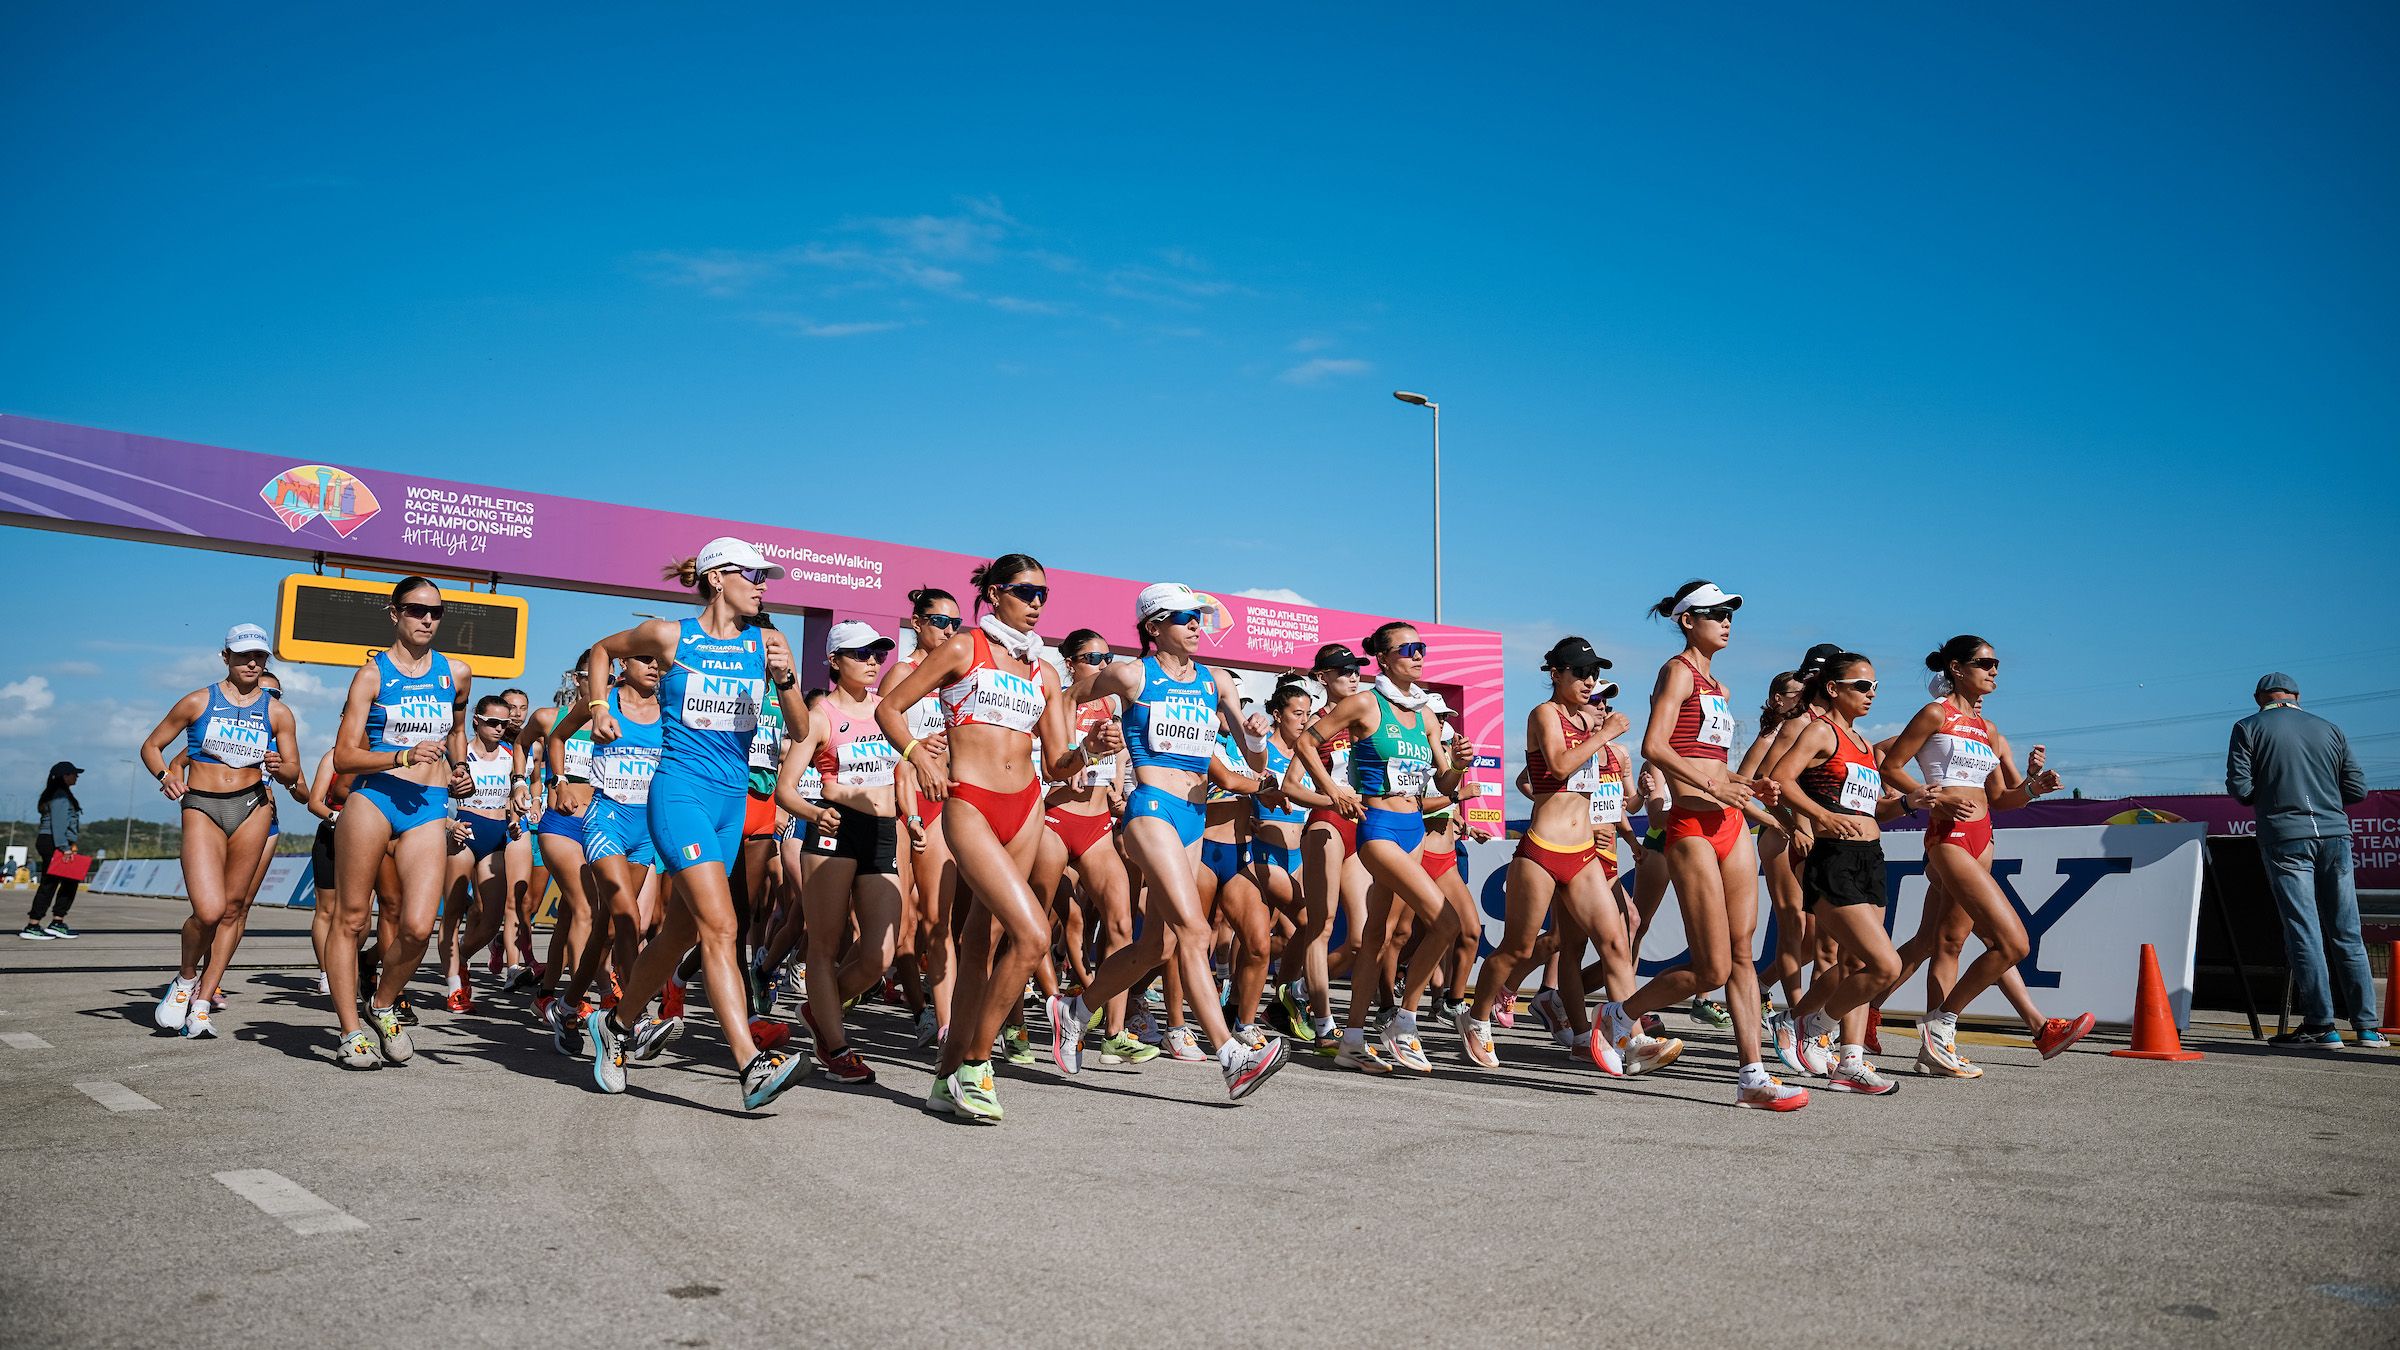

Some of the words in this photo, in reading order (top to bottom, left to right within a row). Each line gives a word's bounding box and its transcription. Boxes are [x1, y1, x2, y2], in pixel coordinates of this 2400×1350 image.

[407, 486, 458, 503] WORLD
[461, 494, 534, 514] ATHLETICS
[405, 499, 439, 513] RACE
[441, 504, 497, 520] WALKING
[500, 511, 534, 525] TEAM
[404, 511, 533, 539] CHAMPIONSHIPS
[402, 527, 467, 556] ANTALYA
[471, 535, 487, 553] 24
[754, 542, 883, 574] #WorldRaceWalking
[791, 568, 882, 590] @waantalya24
[1247, 606, 1276, 618] WORLD
[1277, 611, 1318, 624] ATHLETICS
[1247, 616, 1266, 625] RACE
[1267, 619, 1298, 630] WALKING
[1300, 623, 1319, 632] TEAM
[1247, 625, 1319, 642] CHAMPIONSHIPS
[1247, 636, 1283, 657] ANTALYA
[1285, 641, 1294, 654] 24
[702, 660, 743, 670] ITALIA
[703, 677, 753, 697] NTN
[994, 672, 1034, 697] NTN
[401, 695, 437, 704] ITALIA
[687, 698, 745, 715] CURIAZZI
[978, 691, 1010, 709] GARCÍA
[1012, 698, 1030, 715] LEÓN
[1166, 696, 1205, 706] ITALIA
[401, 704, 442, 718] NTN
[1166, 704, 1208, 724] NTN
[211, 717, 265, 731] ESTONIA
[395, 723, 432, 733] MIHAI
[1712, 717, 1720, 729] Z.
[219, 725, 259, 744] NTN
[855, 734, 888, 742] JAPA
[1156, 723, 1199, 740] GIORGI
[852, 743, 892, 758] NTN
[1965, 740, 1992, 758] NTN
[619, 760, 656, 775] NTN
[1857, 766, 1880, 785] NTN
[477, 776, 505, 786] NTN
[606, 778, 628, 789] TELETOR
[1397, 775, 1420, 786] SENA
[475, 789, 502, 797] OUTARD
[1479, 785, 1494, 793] TN
[1594, 783, 1620, 797] NTN
[1593, 800, 1614, 811] PENG
[1469, 811, 1501, 820] SEIKO
